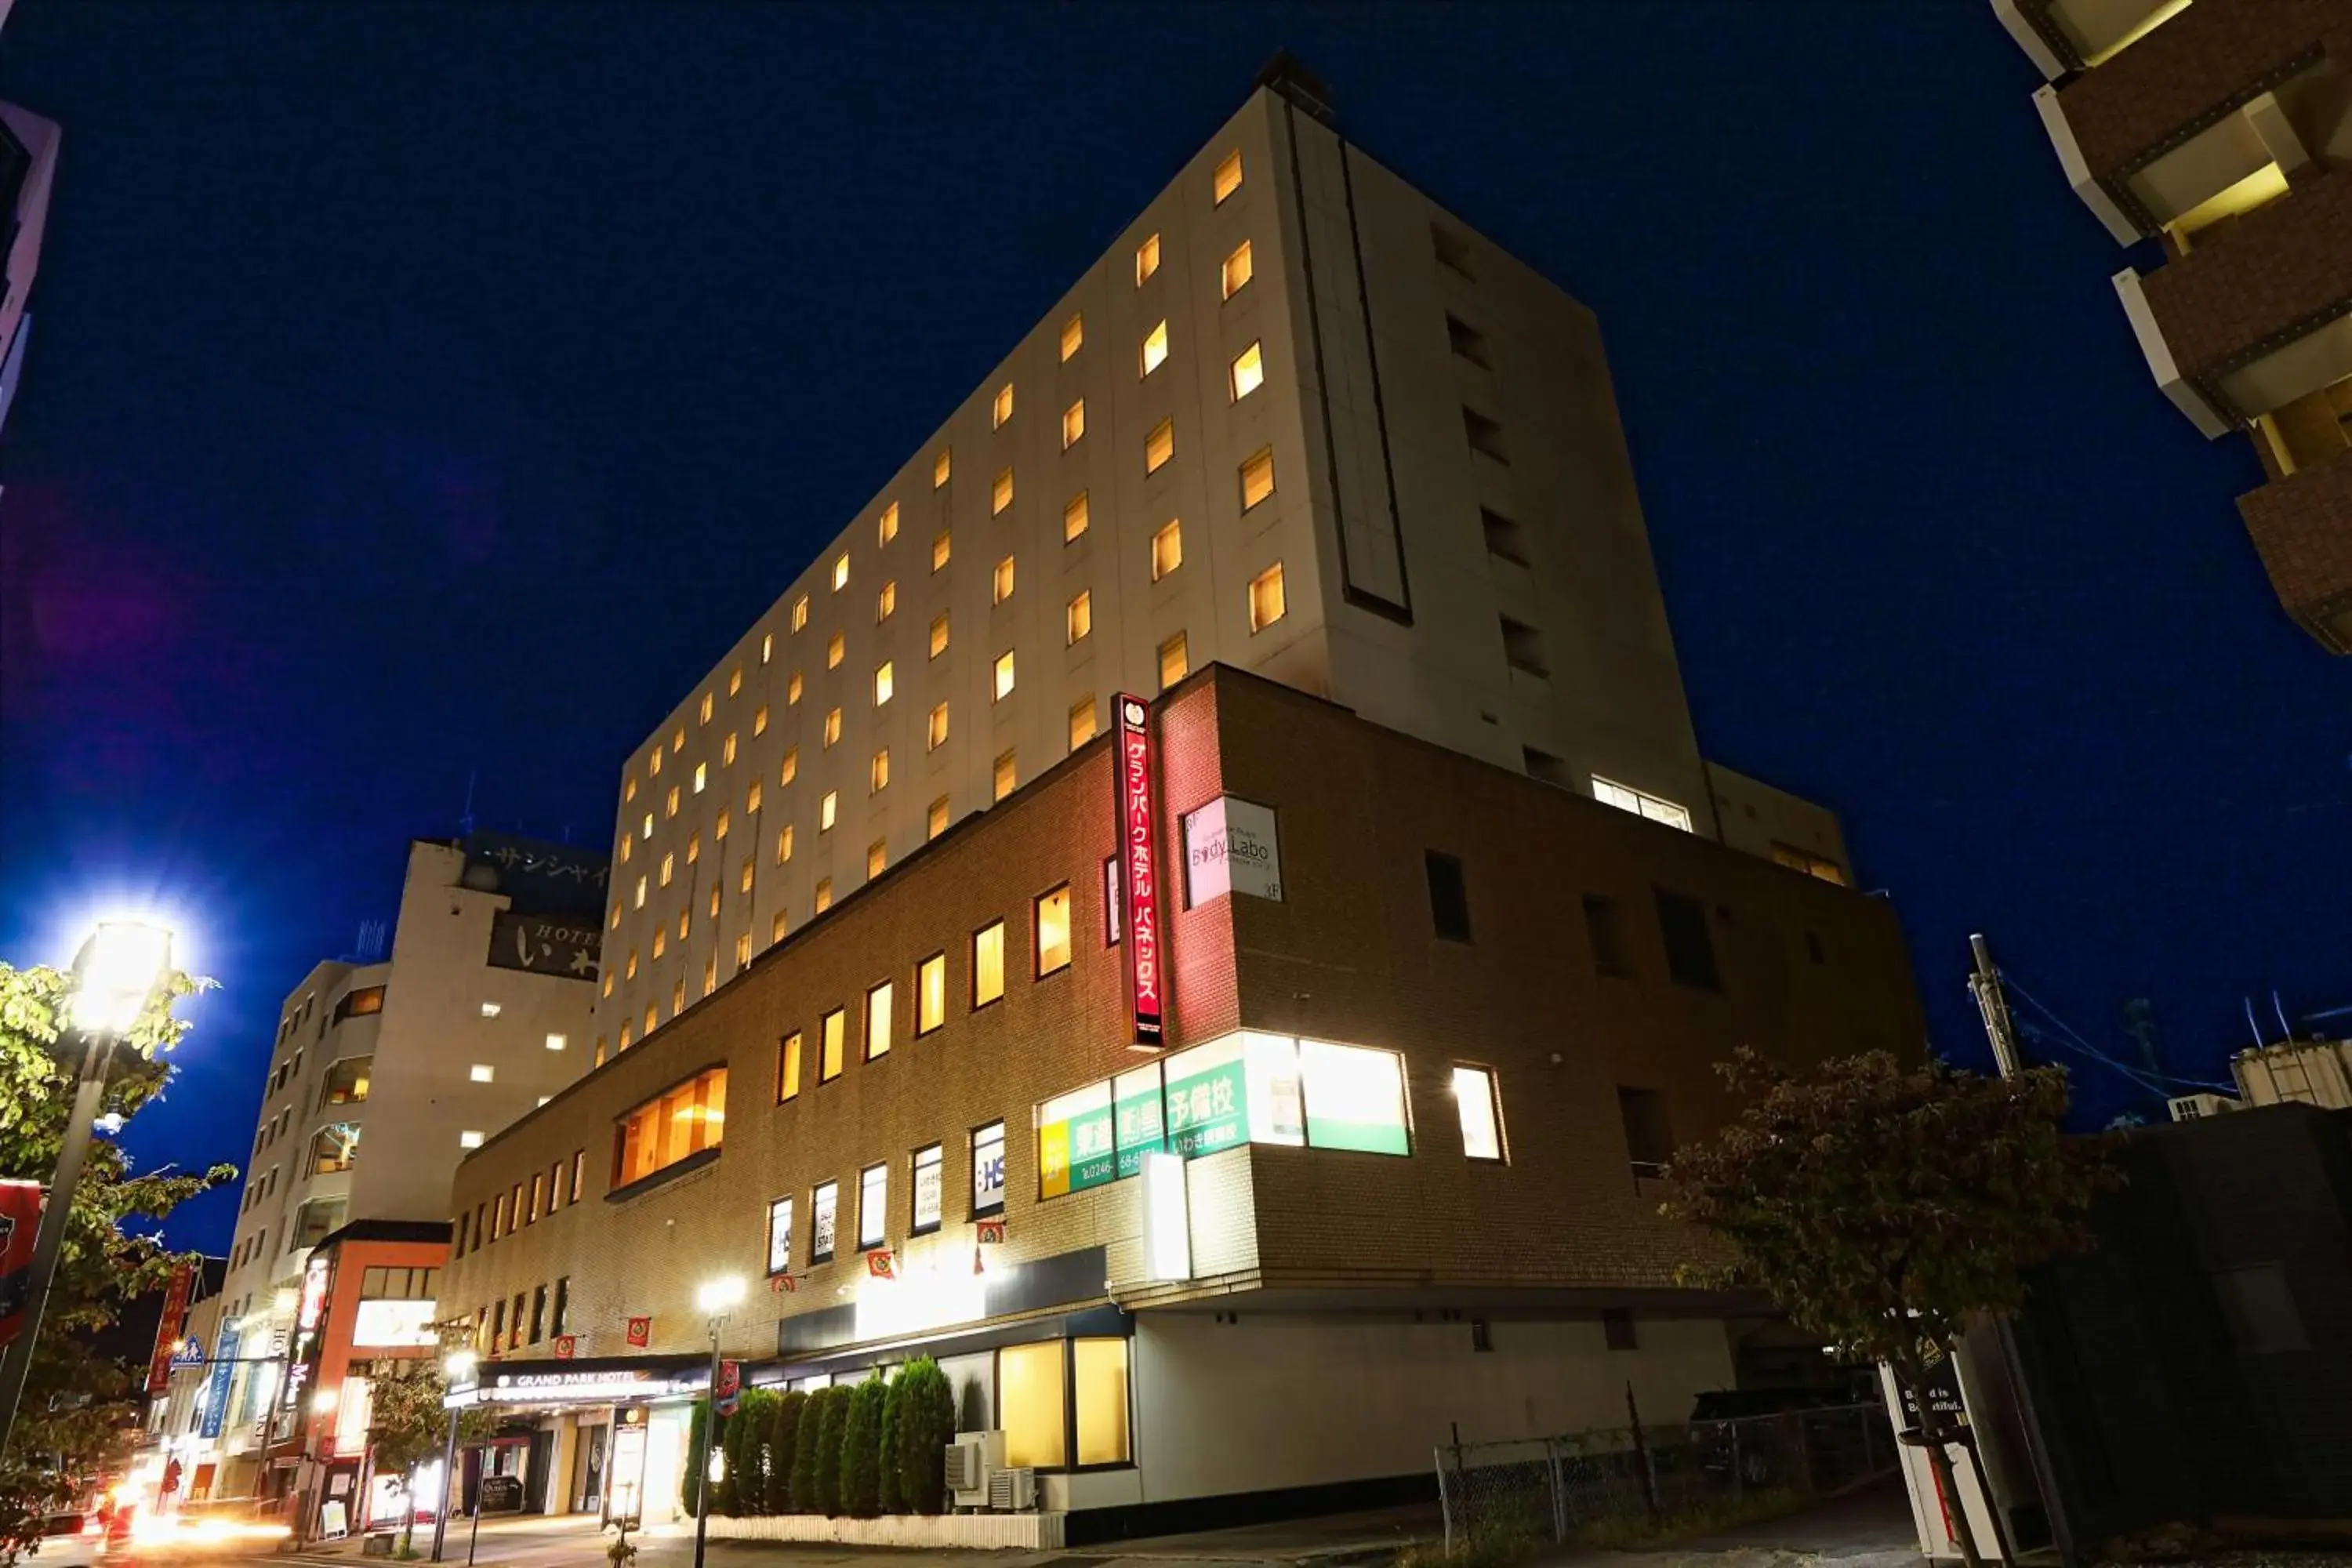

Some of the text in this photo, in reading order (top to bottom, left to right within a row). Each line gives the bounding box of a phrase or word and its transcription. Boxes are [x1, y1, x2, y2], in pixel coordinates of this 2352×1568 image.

[1128, 742, 1151, 898] グランパークホテル
[1229, 834, 1269, 860] Labo
[536, 924, 602, 948] HOTE
[1134, 904, 1156, 1000] パネックス
[517, 1370, 636, 1387] GRAND PARK HOTEL
